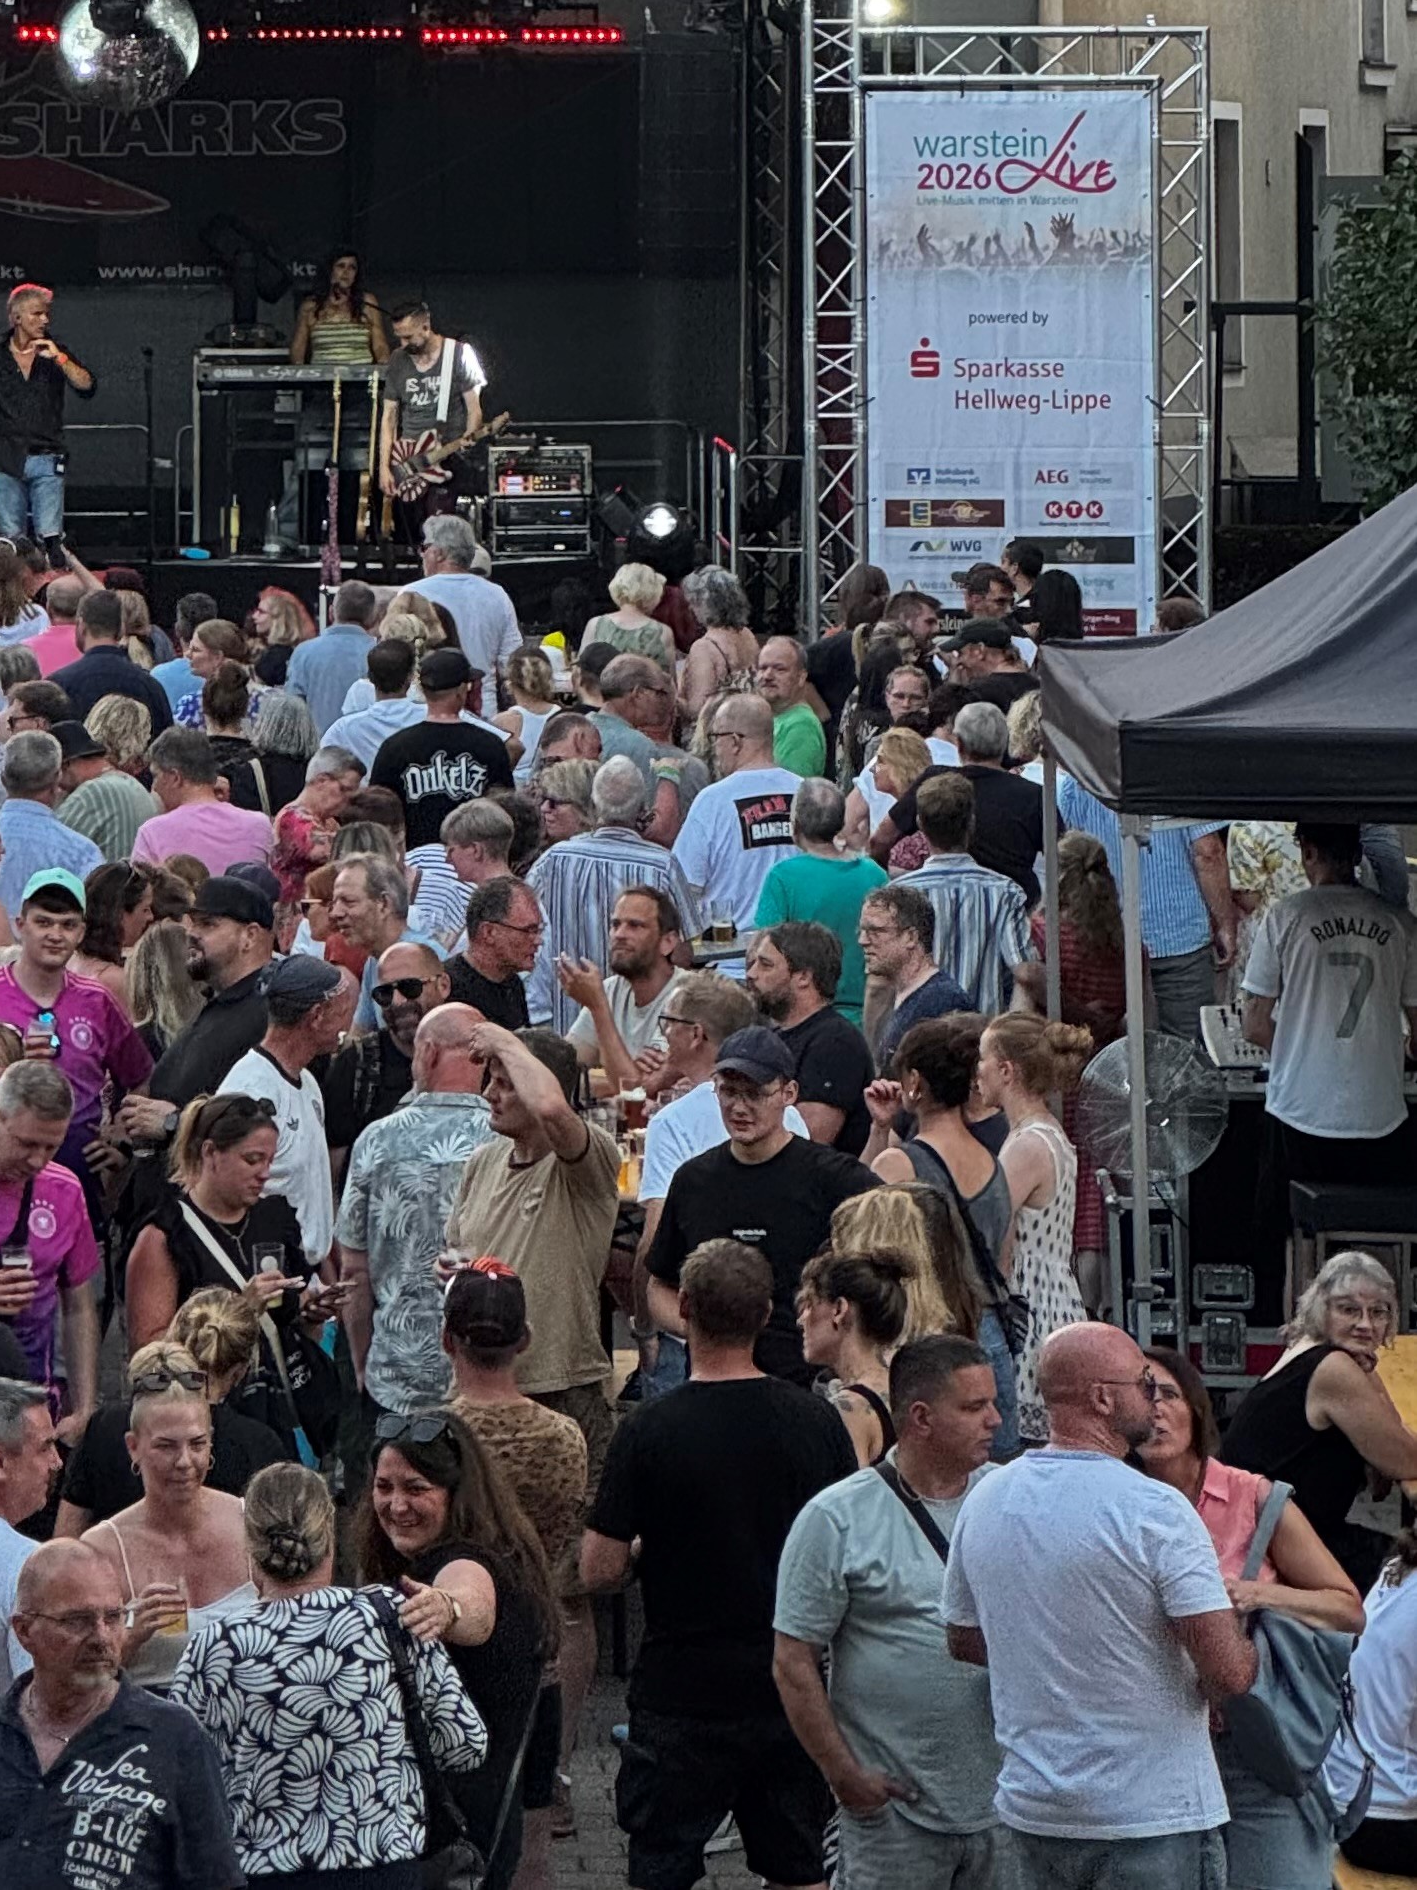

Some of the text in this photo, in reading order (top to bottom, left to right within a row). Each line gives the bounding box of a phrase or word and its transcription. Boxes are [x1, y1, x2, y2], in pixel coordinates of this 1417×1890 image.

[913, 127, 1048, 157] warstein
[917, 162, 992, 190] 2026
[916, 194, 1079, 206] Live-Musik mitten in Warstein
[968, 311, 1049, 327] powered by
[953, 357, 1065, 383] Sparkasse
[954, 388, 1112, 415] Hellweg-Lippe
[1035, 470, 1069, 485] AEG
[950, 540, 982, 552] WVG
[404, 752, 488, 801] Onkelz
[1310, 917, 1391, 945] RONALDO
[1327, 951, 1375, 1039] 7
[94, 1743, 153, 1784] Sea
[61, 1760, 168, 1824] Voyage
